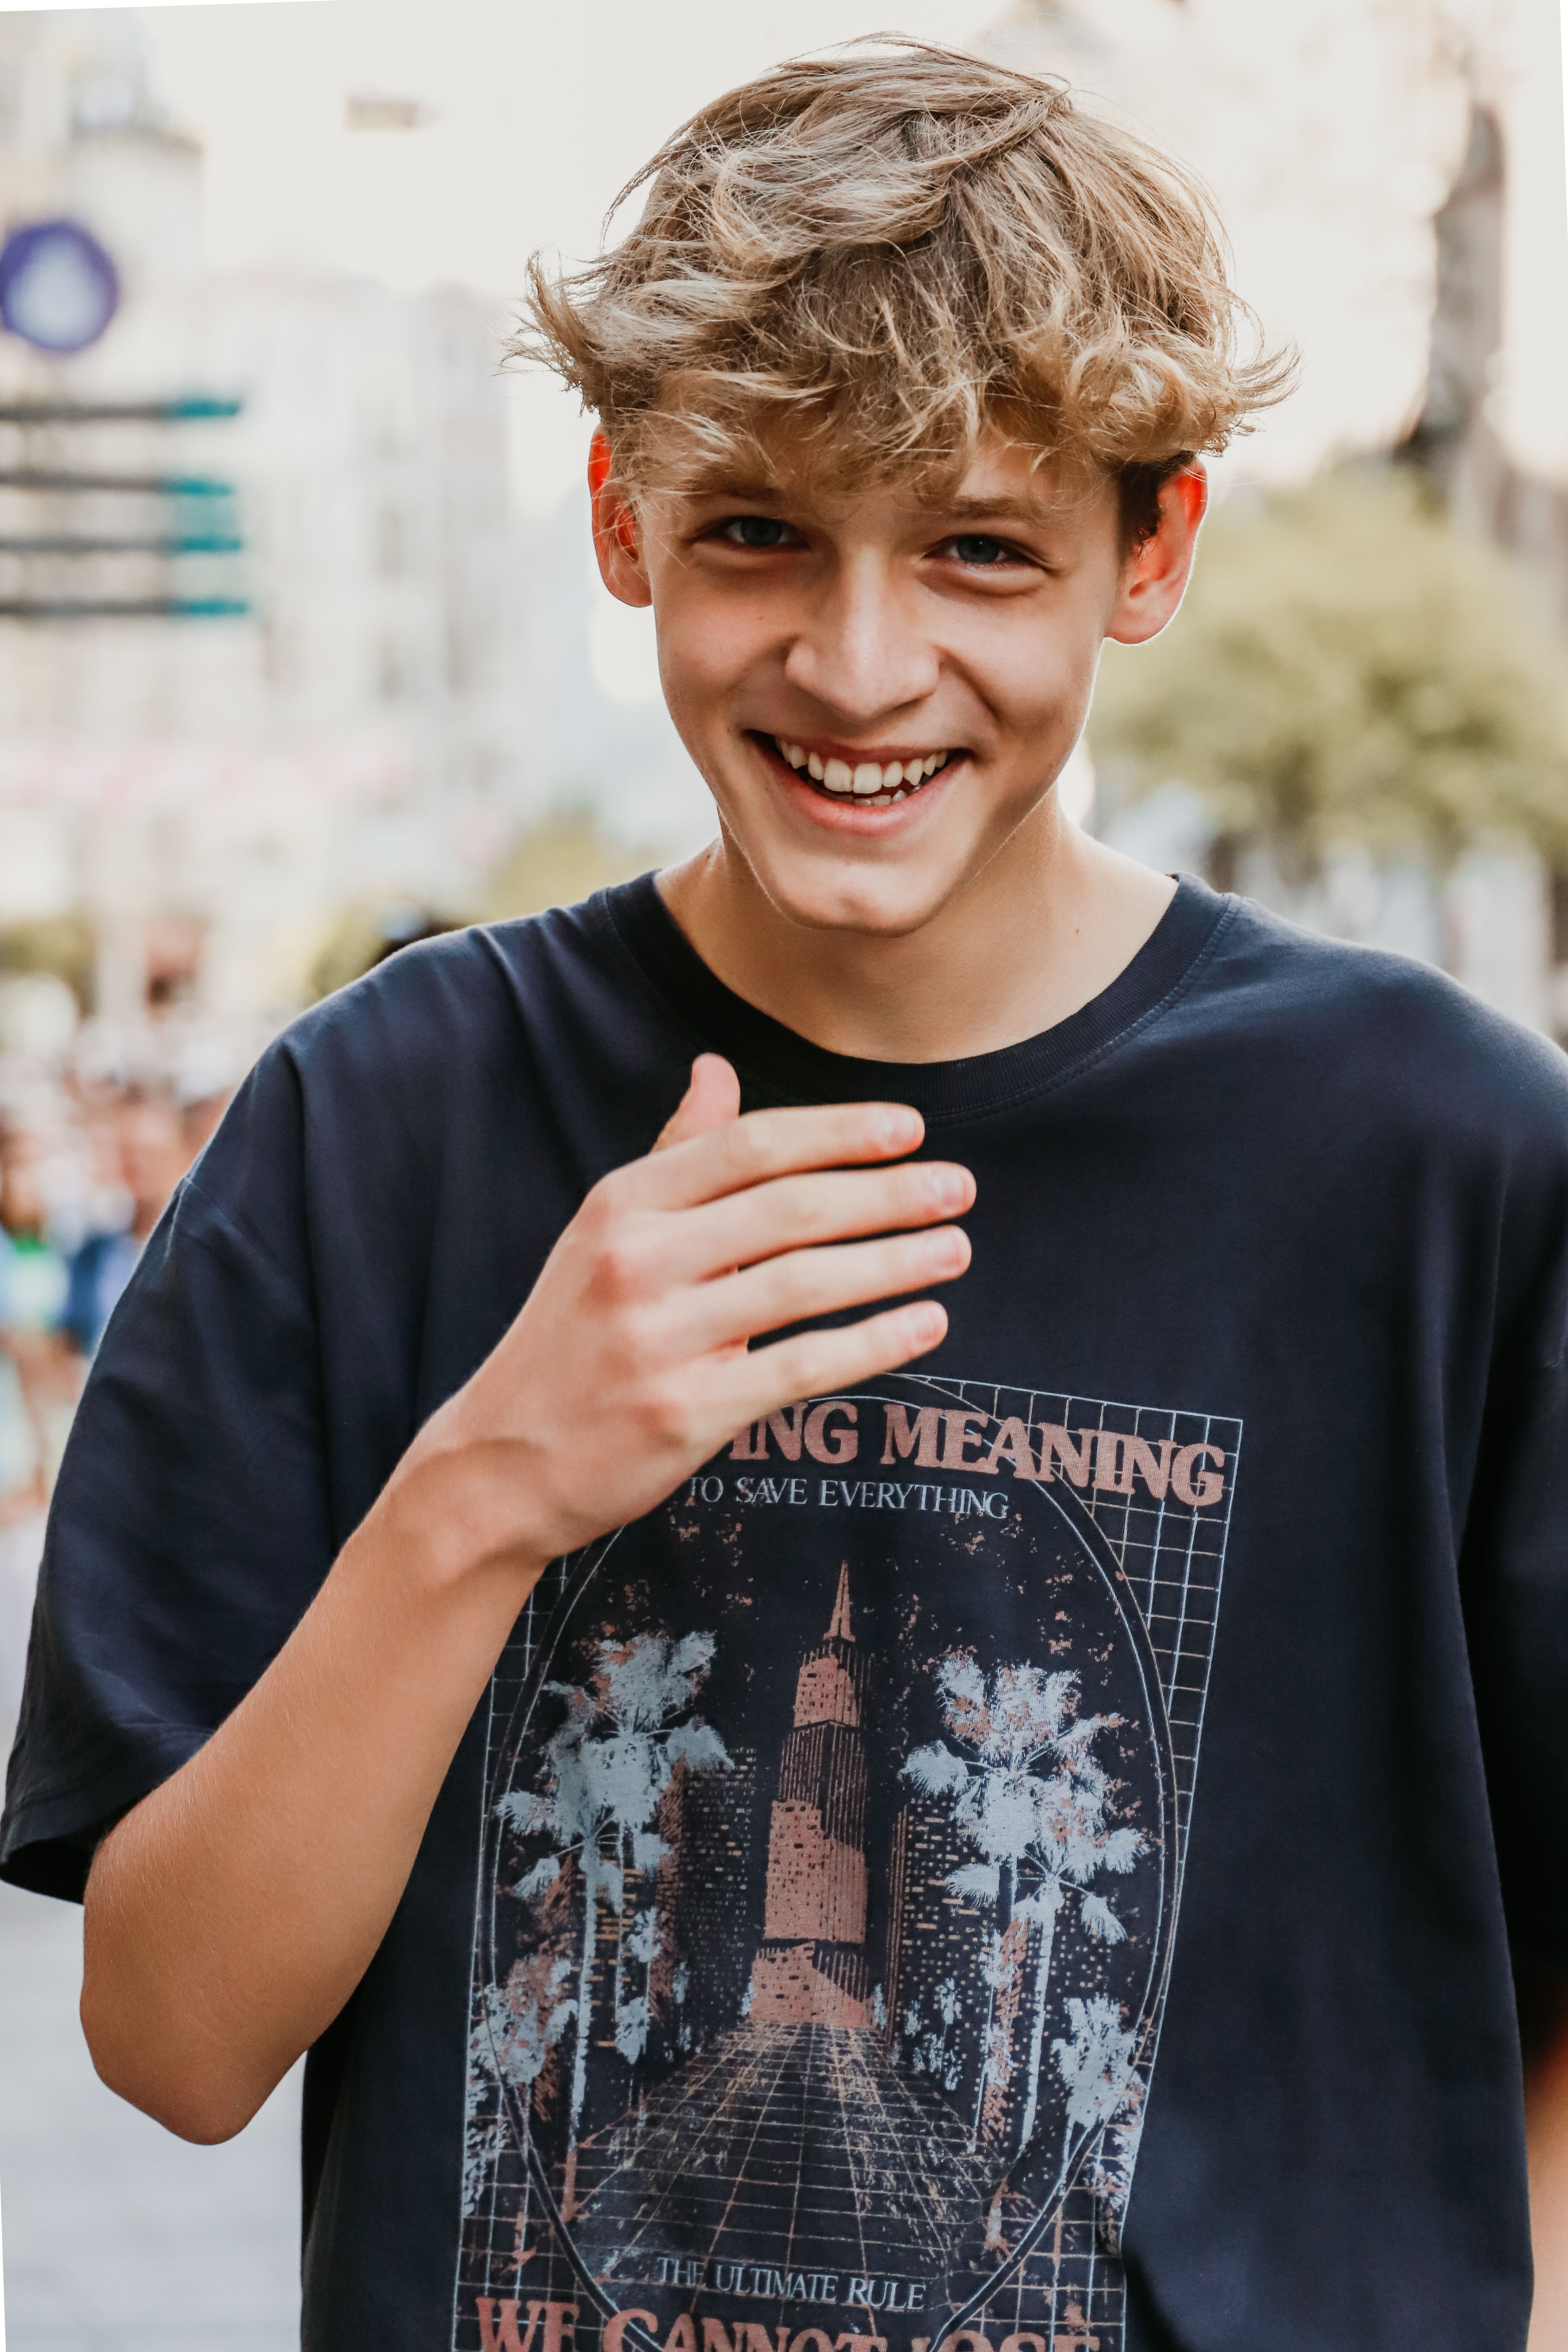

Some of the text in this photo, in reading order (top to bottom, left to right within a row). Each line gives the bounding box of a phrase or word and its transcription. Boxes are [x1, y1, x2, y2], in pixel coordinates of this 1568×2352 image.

[880, 1404, 1225, 1507] MEANING
[687, 1476, 1009, 1519] TO SAVE EVERYTHING
[657, 2257, 926, 2310] THE ULTIMATE RULE
[476, 2297, 580, 2352] WE
